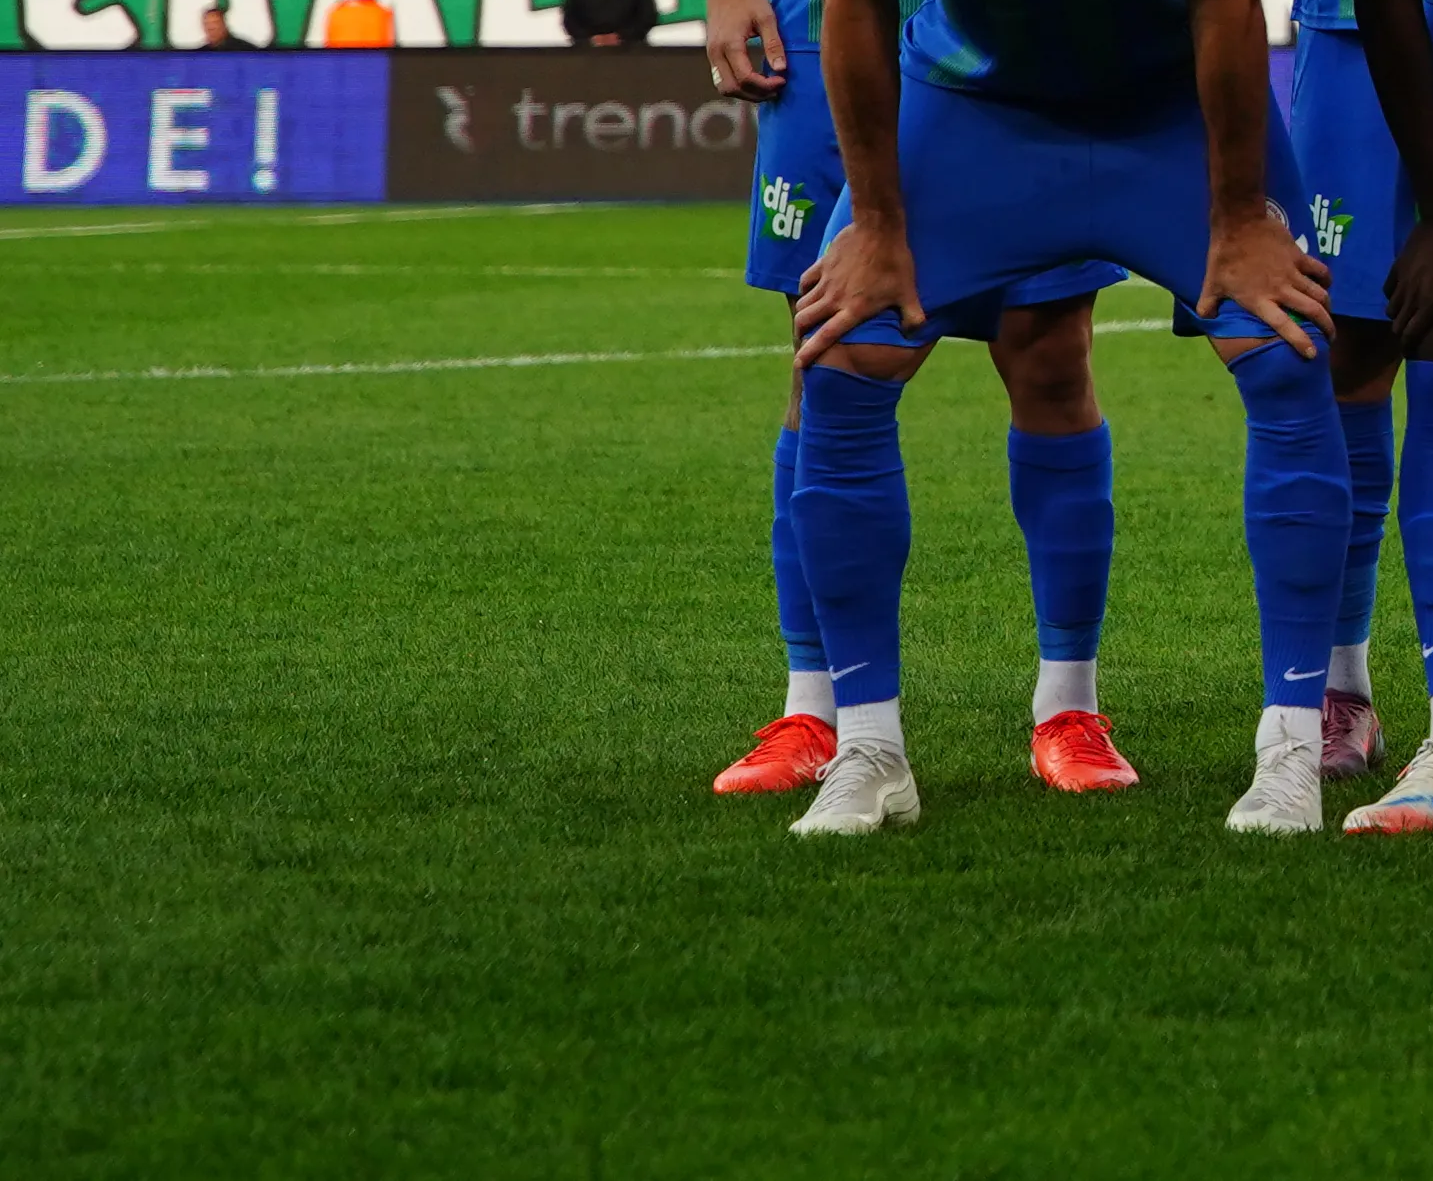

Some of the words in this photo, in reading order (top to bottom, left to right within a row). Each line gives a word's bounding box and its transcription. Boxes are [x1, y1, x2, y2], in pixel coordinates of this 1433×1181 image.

[512, 88, 757, 150] trend
[763, 176, 791, 214] di
[772, 204, 805, 240] di
